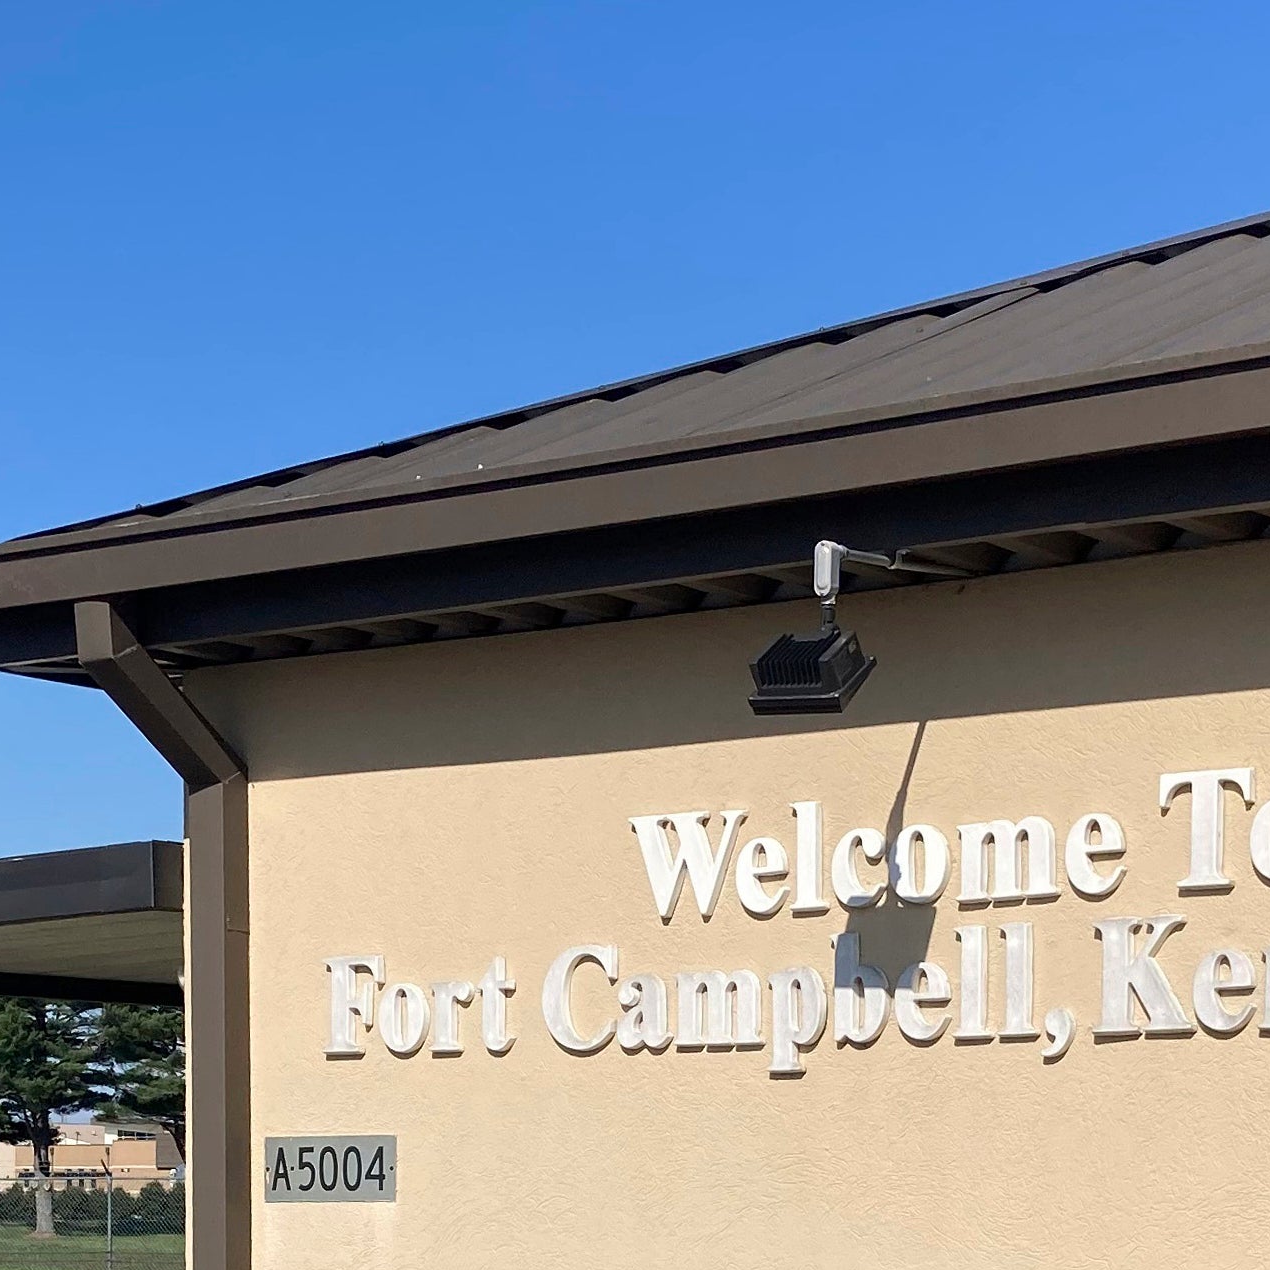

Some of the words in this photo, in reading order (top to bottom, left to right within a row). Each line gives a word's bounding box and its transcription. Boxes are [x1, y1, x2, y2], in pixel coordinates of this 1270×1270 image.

[628, 800, 1128, 921] Welcome
[322, 954, 517, 1060] Fort
[541, 922, 1076, 1079] Campbell,
[271, 1145, 386, 1191] A5004
